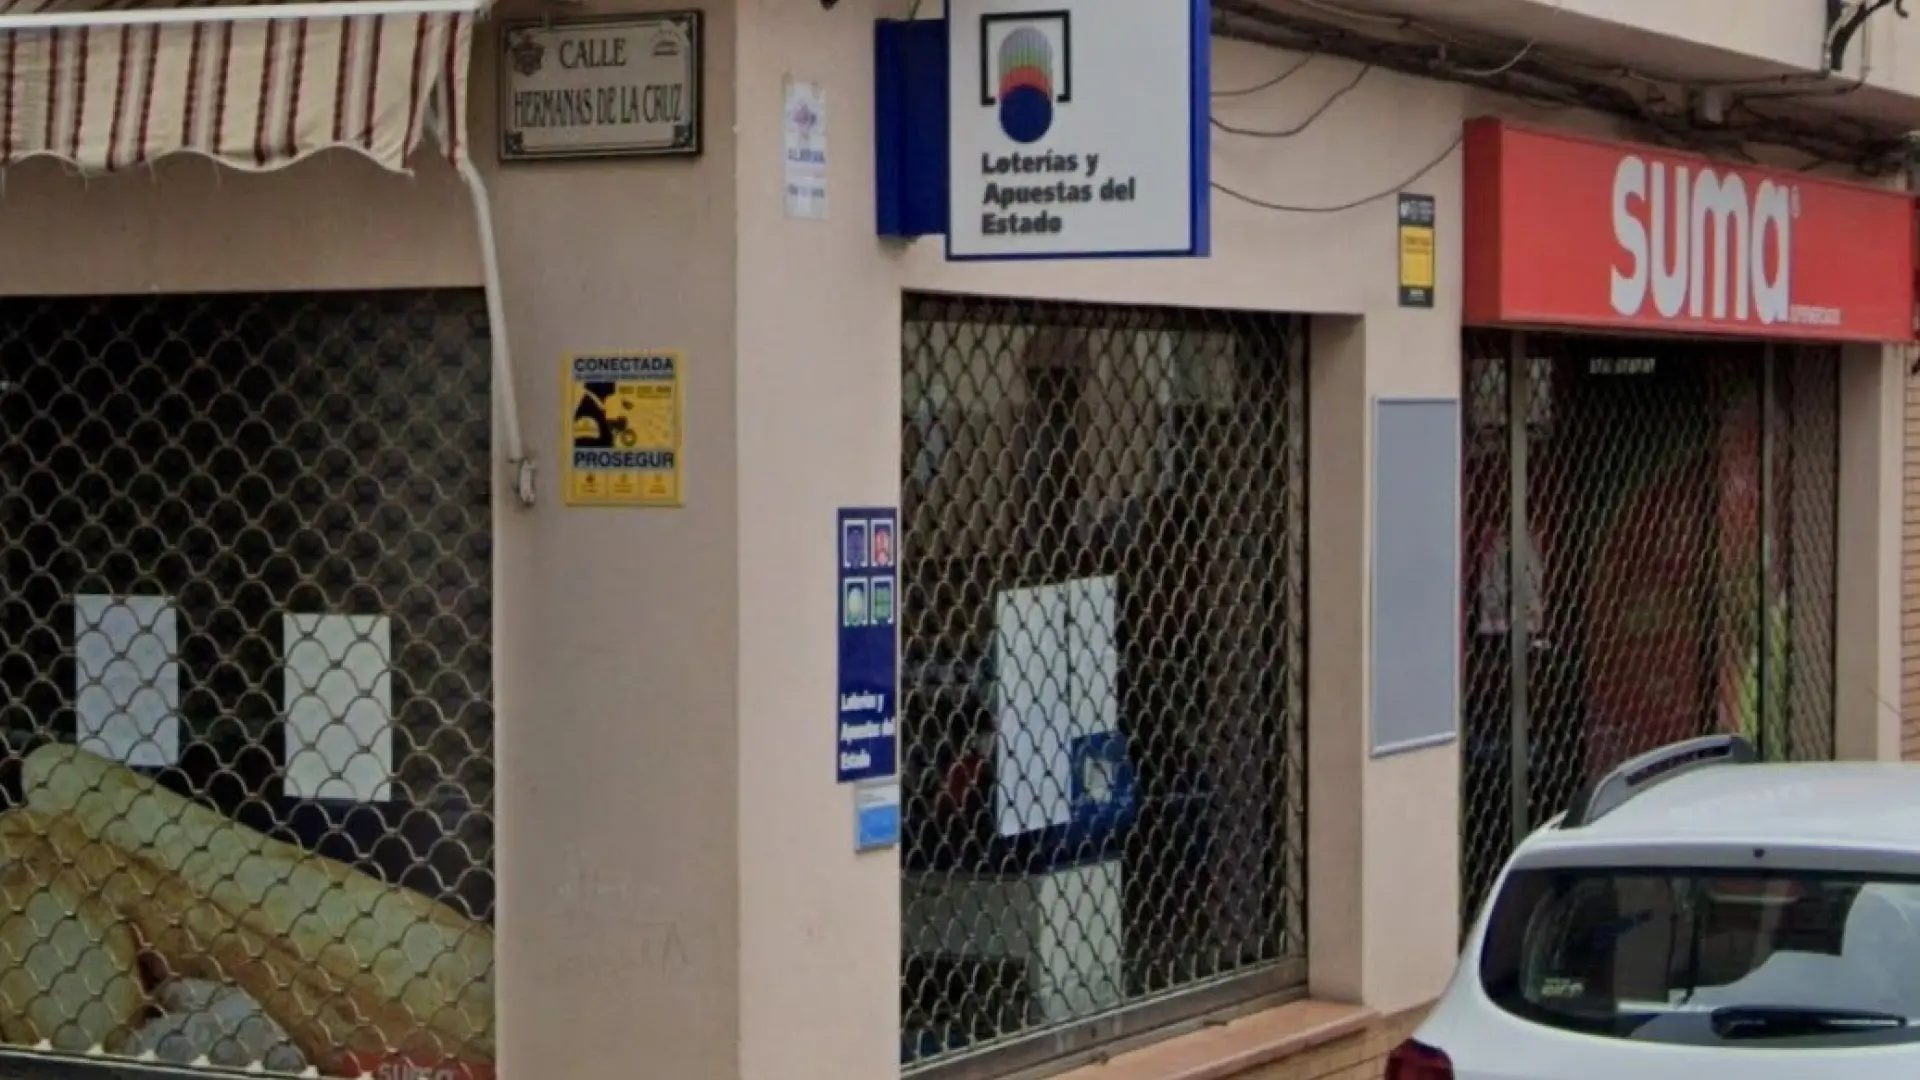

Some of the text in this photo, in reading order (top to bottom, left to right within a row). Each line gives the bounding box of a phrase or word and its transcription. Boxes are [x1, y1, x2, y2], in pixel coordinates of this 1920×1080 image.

[559, 38, 626, 69] CALLE
[514, 83, 682, 128] HERMANAS DE LA CRUZ
[982, 149, 1099, 177] Loterías y
[983, 176, 1135, 210] Apuestas del
[982, 209, 1063, 235] Estado
[574, 357, 673, 371] CONECTADA
[574, 452, 674, 469] PROSEGUR
